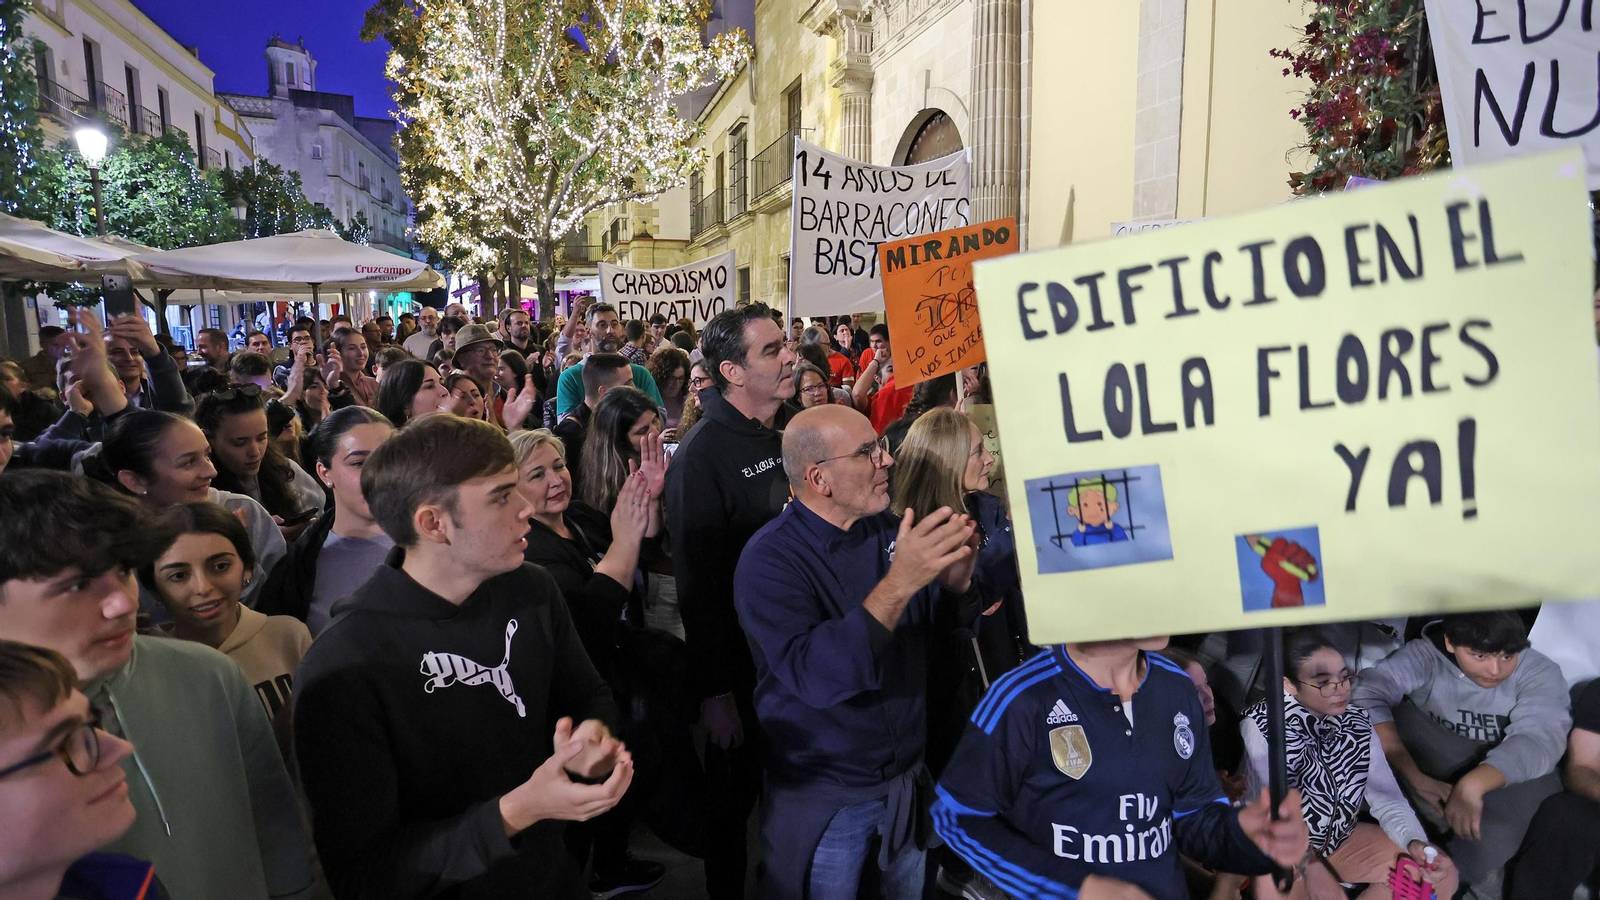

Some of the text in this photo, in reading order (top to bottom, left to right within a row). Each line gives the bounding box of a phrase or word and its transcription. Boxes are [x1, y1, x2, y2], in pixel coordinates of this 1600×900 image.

[1472, 0, 1593, 45] EDI
[1474, 50, 1600, 147] NU
[796, 150, 832, 190] 14
[841, 165, 914, 193] AÑOS
[800, 196, 970, 239] BARRACONES
[355, 264, 412, 276] Cruzcampo
[815, 237, 887, 279] BAST
[886, 226, 1010, 273] MIRANDO
[1017, 196, 1525, 341] EDIFICIO EN EL
[612, 265, 727, 295] CHABOLISMO
[618, 296, 725, 323] EDUCATIVO
[906, 326, 956, 364] LO QUE
[920, 354, 942, 377] NOS
[1058, 317, 1500, 444] LOLA FLORES
[1334, 416, 1478, 520] YA!
[1046, 713, 1079, 725] adidas
[1429, 710, 1500, 742] NORTH
[1457, 708, 1496, 729] THE
[1119, 792, 1158, 822] Fly
[1051, 815, 1173, 863] Emirat
